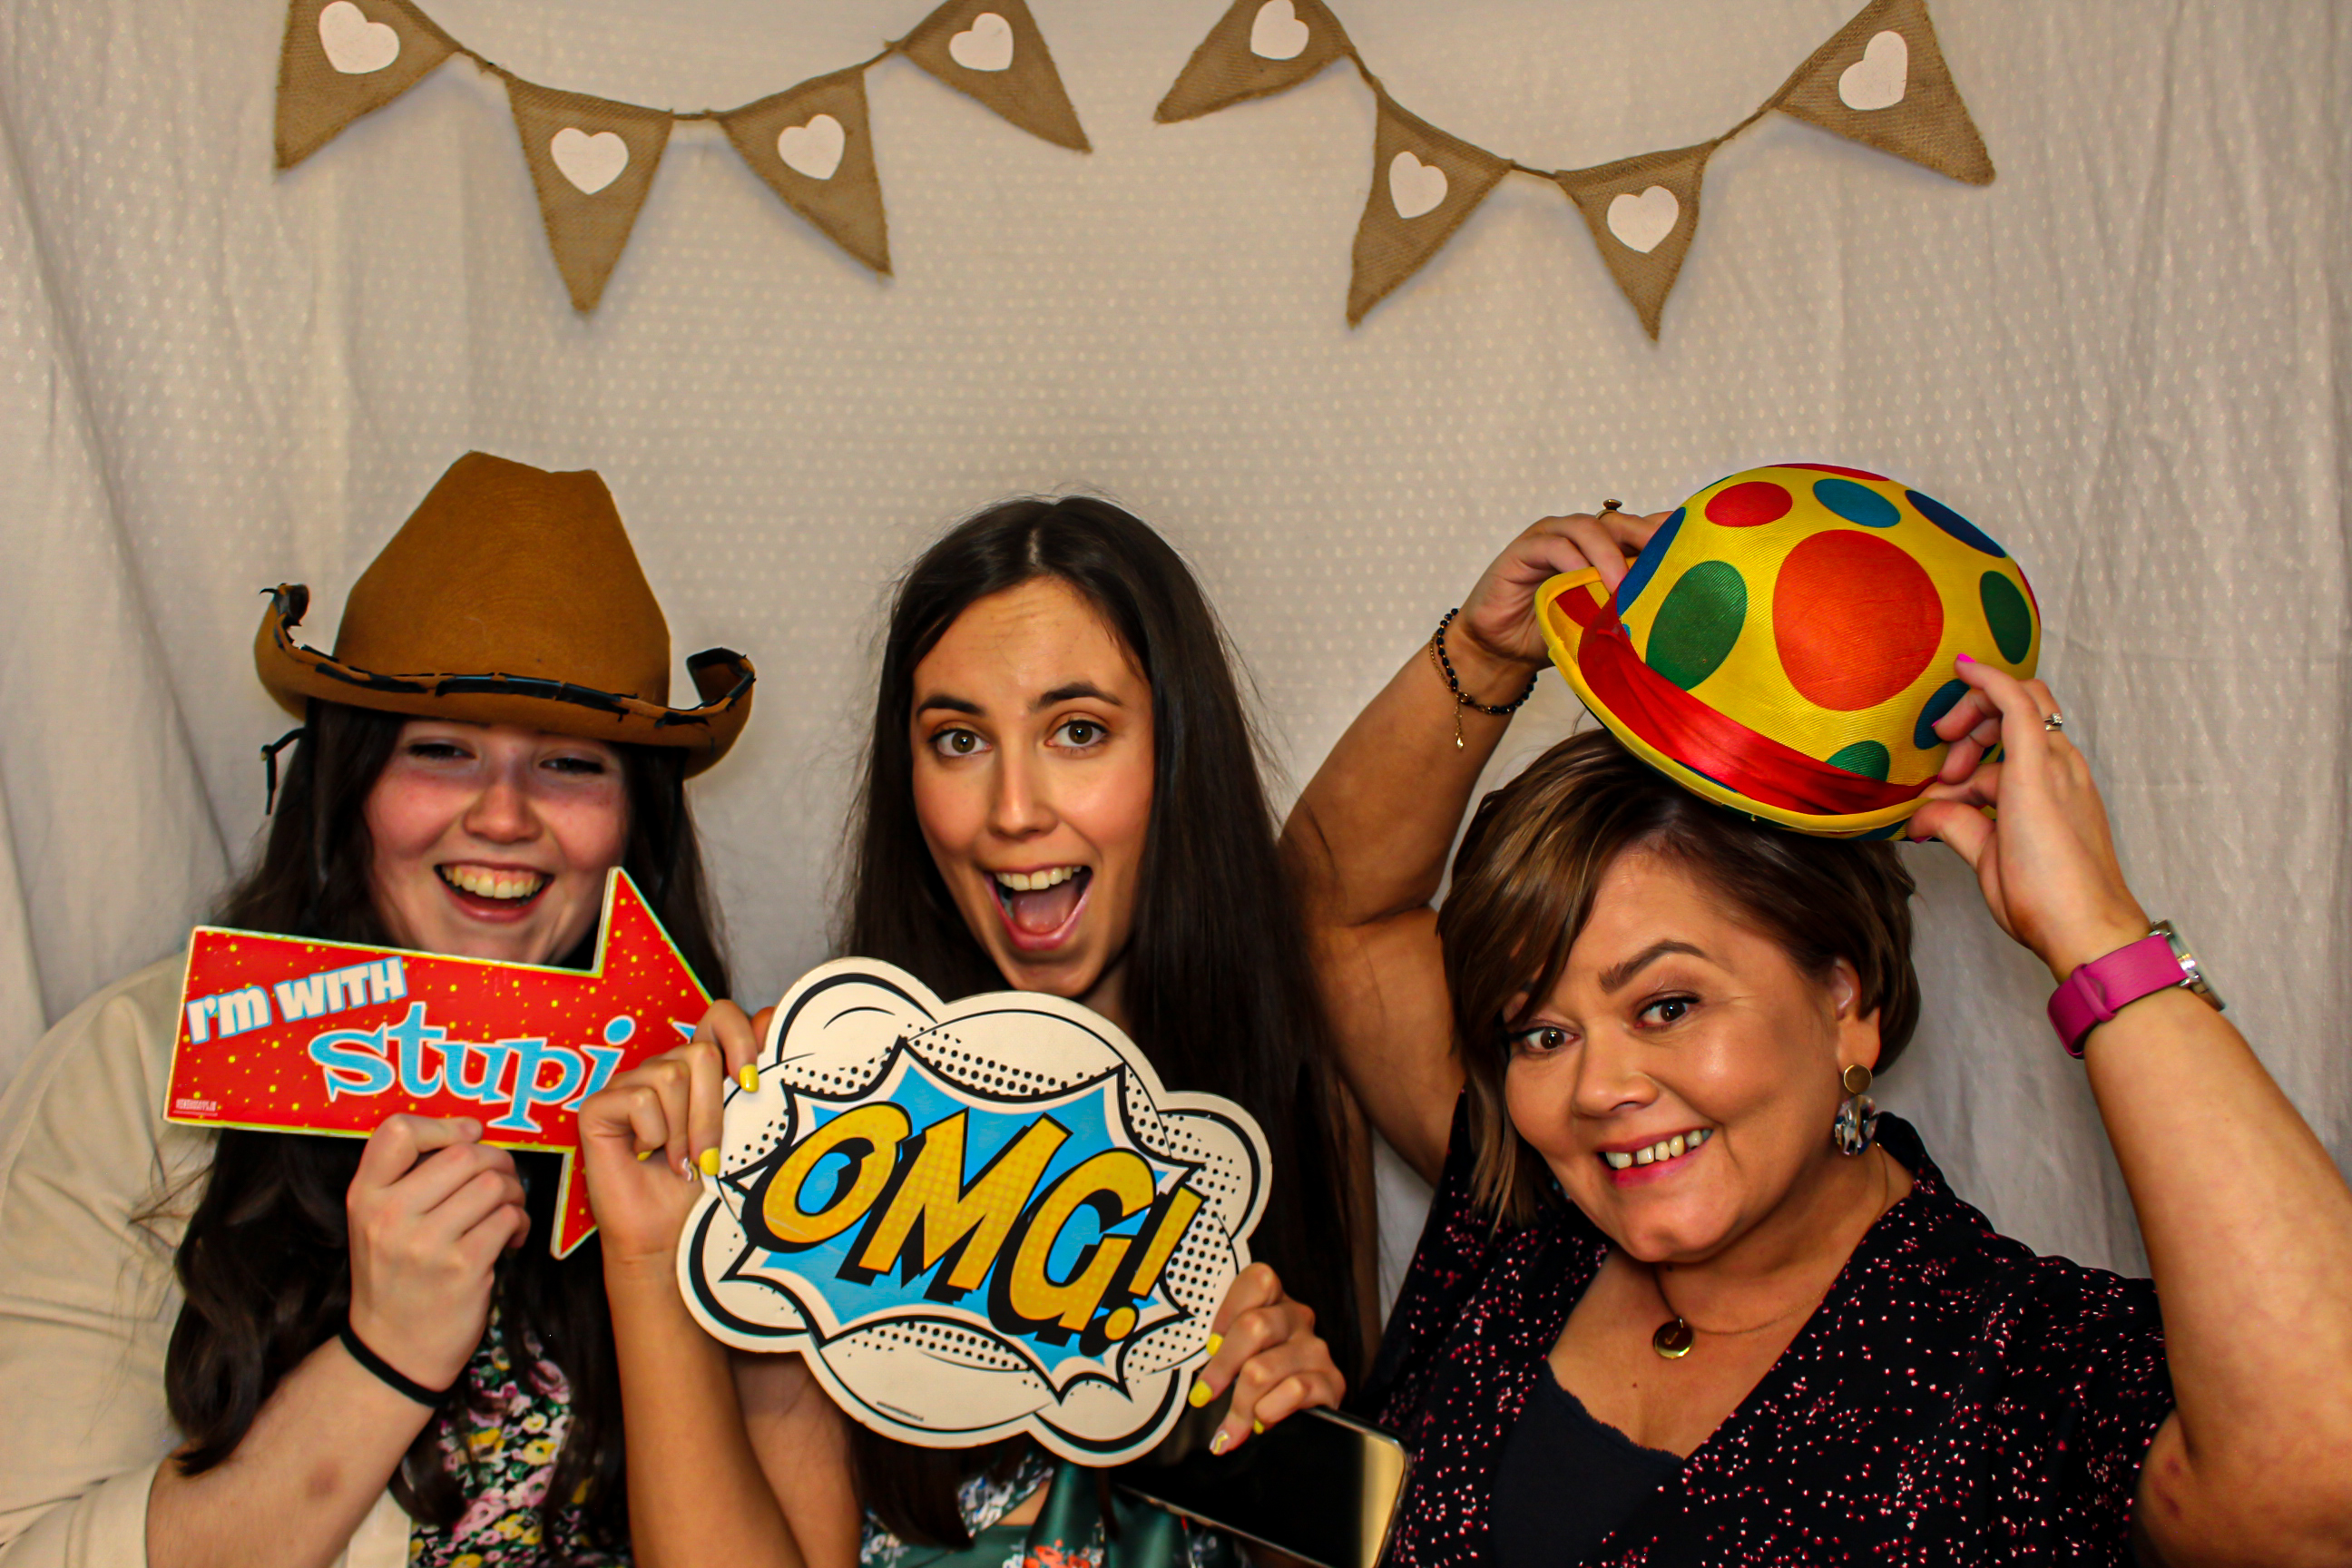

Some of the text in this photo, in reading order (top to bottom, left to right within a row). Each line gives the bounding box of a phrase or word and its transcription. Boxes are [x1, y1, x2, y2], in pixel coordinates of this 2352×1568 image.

[273, 956, 407, 1023] WITH
[308, 1001, 697, 1133] stupi
[751, 1100, 1205, 1353] OMG!
